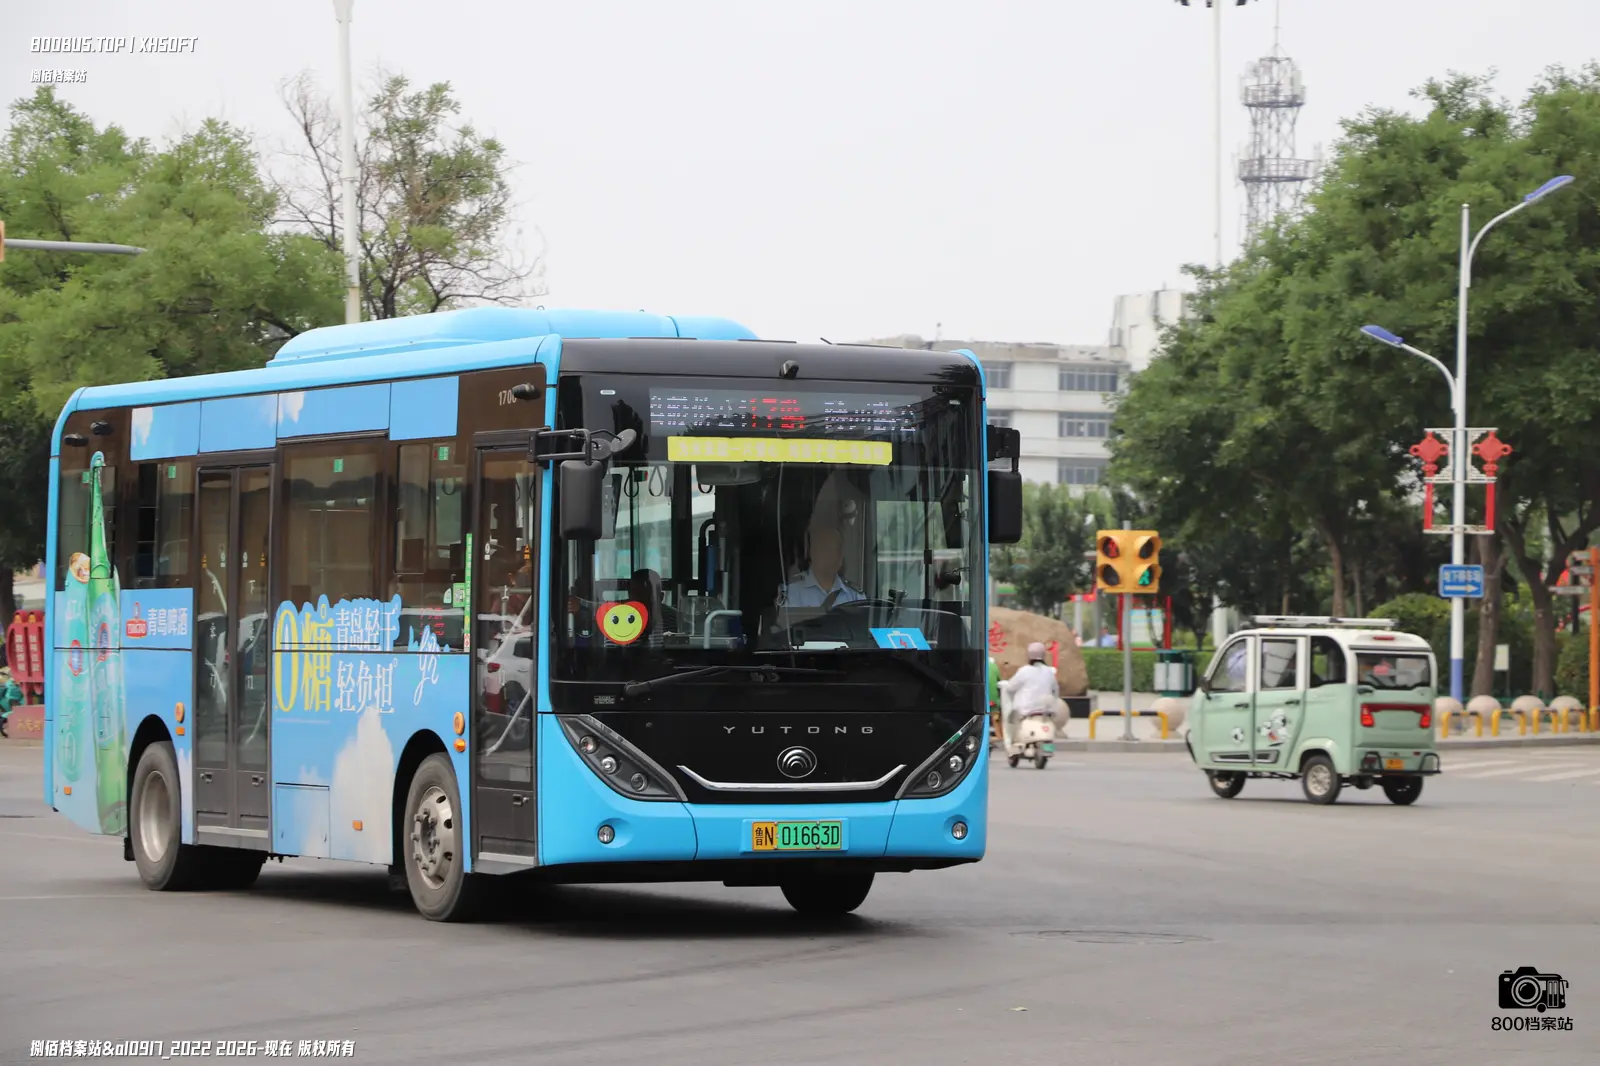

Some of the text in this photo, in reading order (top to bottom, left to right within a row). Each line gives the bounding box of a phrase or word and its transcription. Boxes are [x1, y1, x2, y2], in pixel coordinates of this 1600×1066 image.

[334, 658, 399, 714] 轻负担
[723, 725, 874, 735] YUTONG
[781, 825, 840, 846] 01663D
